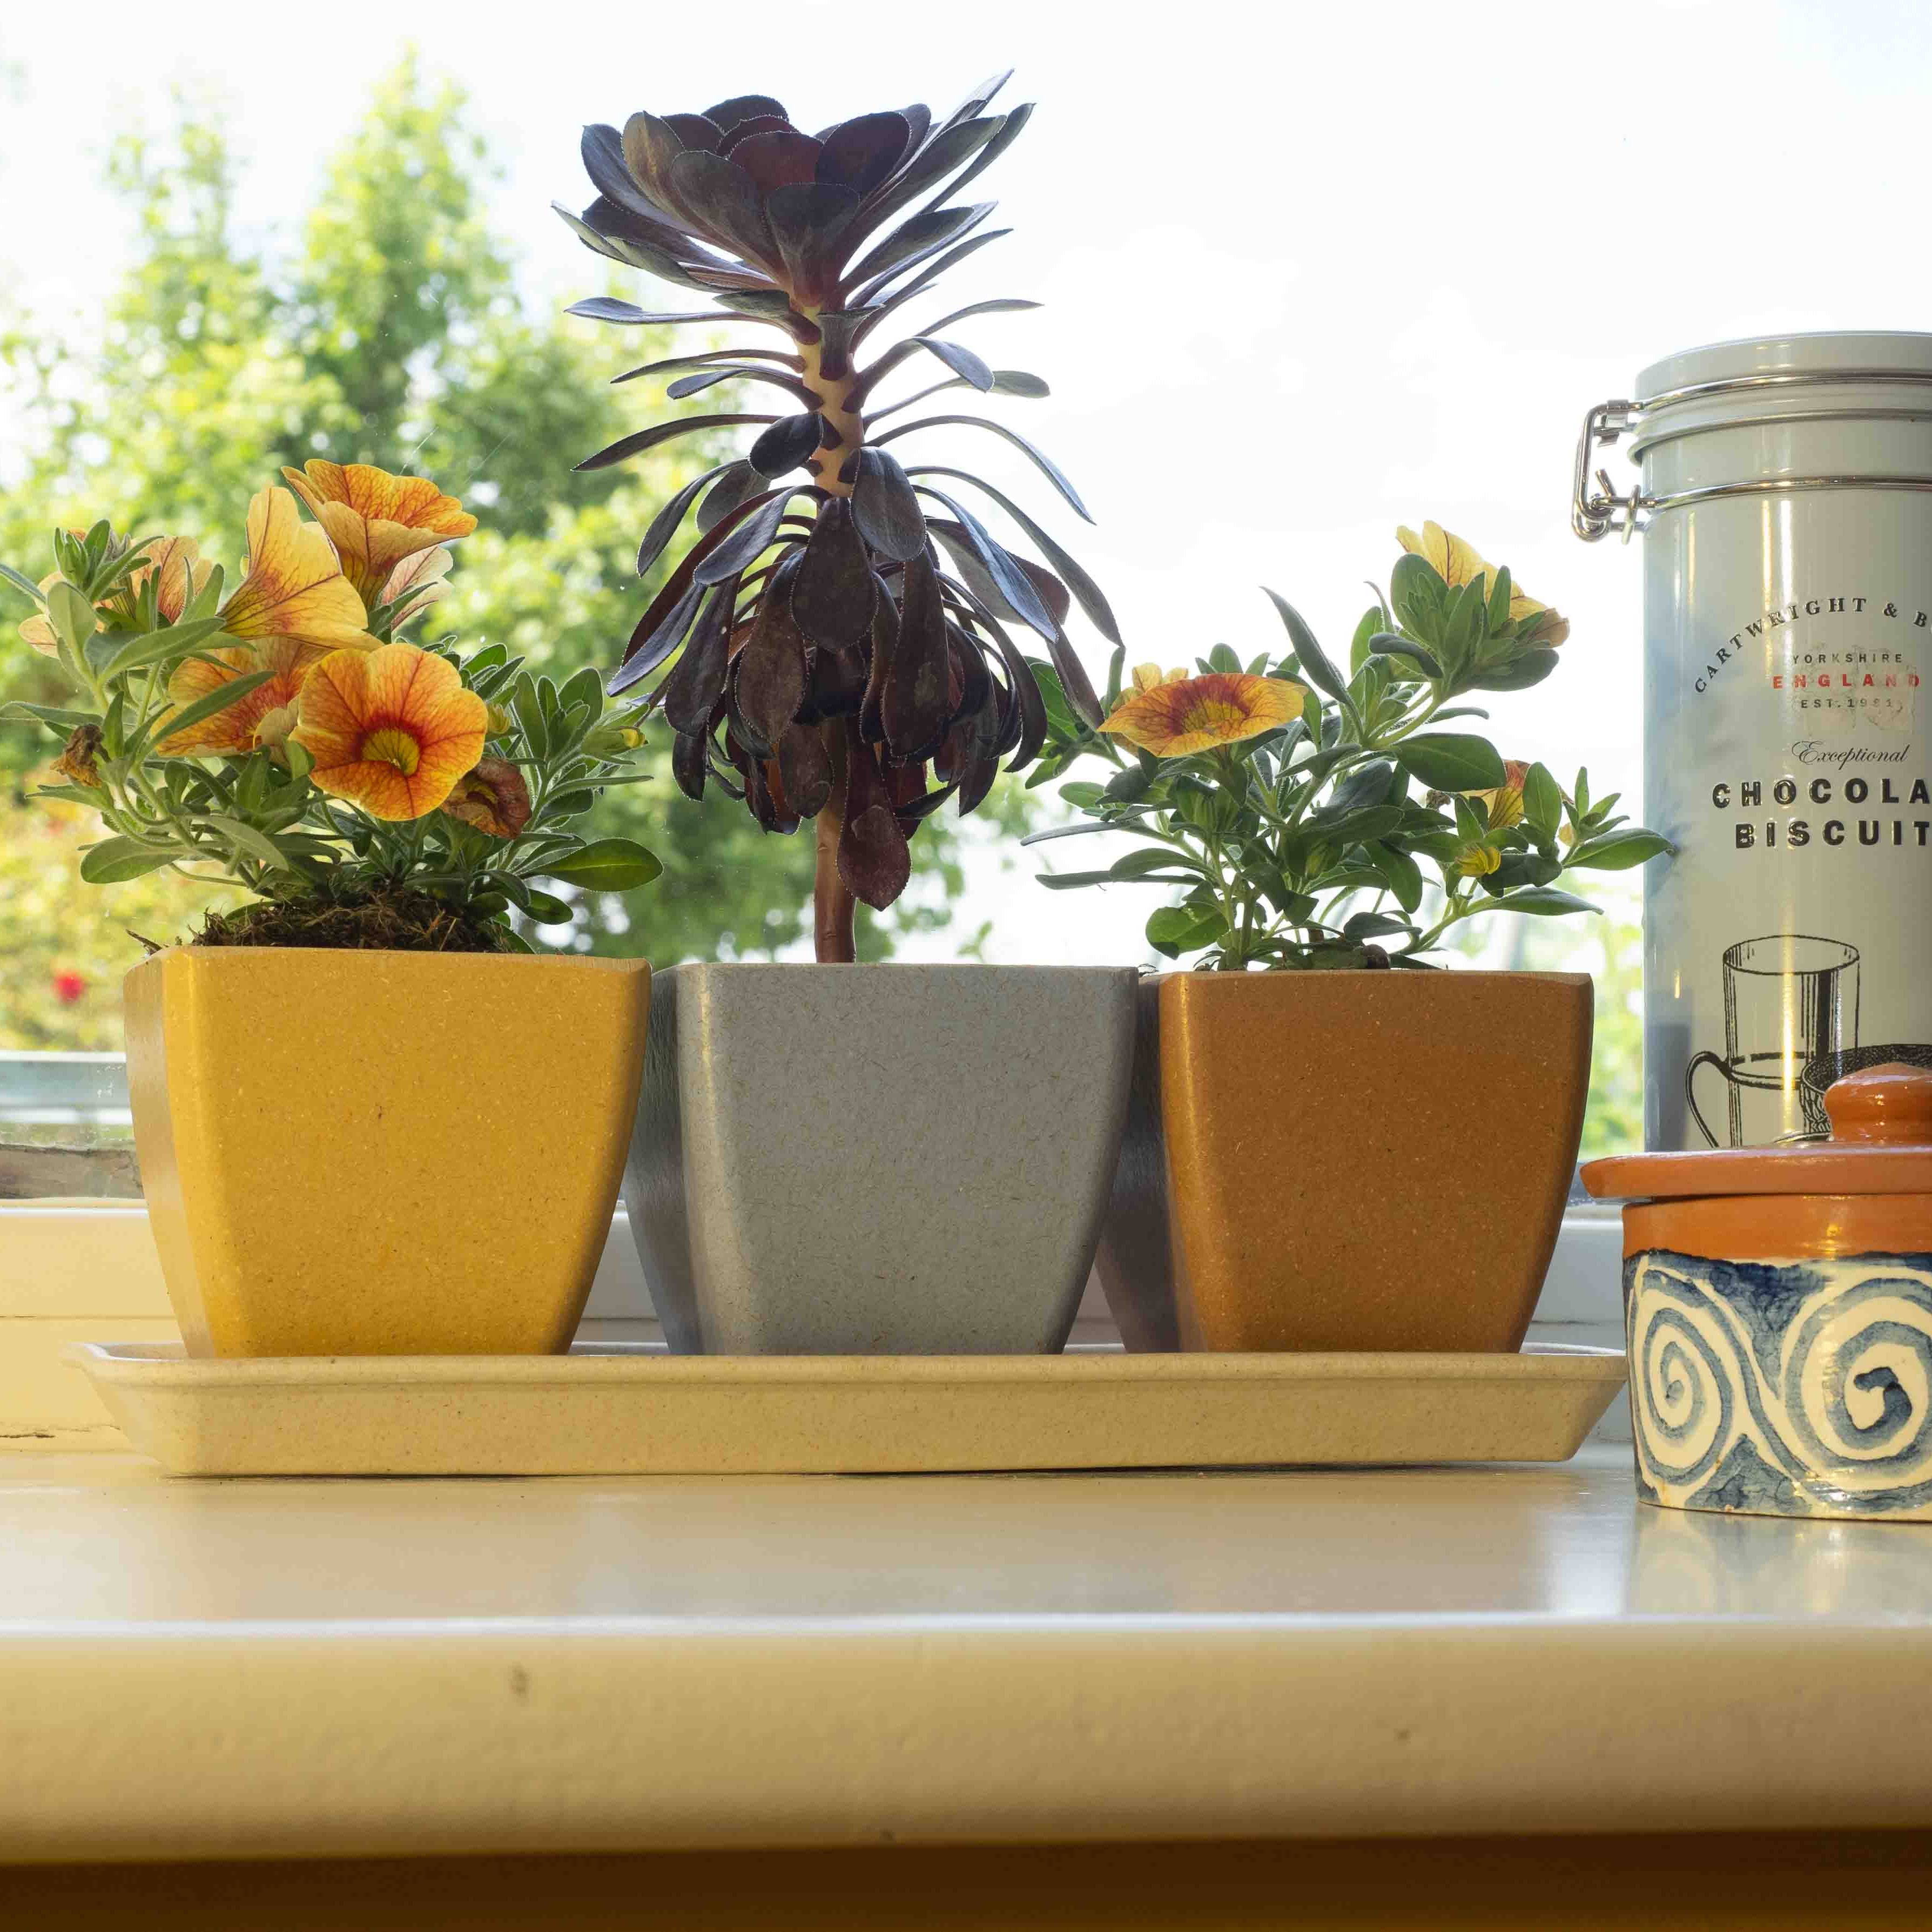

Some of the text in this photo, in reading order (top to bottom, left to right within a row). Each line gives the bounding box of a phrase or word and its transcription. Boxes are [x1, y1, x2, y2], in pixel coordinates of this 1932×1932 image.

[1695, 597, 1866, 692] CARTWRIGHT
[1883, 603, 1898, 618] &
[1793, 654, 1902, 664] YORKSHIRE
[1773, 674, 1920, 689] ENGLAND
[1792, 741, 1910, 770] Exceptional
[1712, 778, 1930, 808] CHOCOLA
[1735, 820, 1930, 848] BISCUIT
